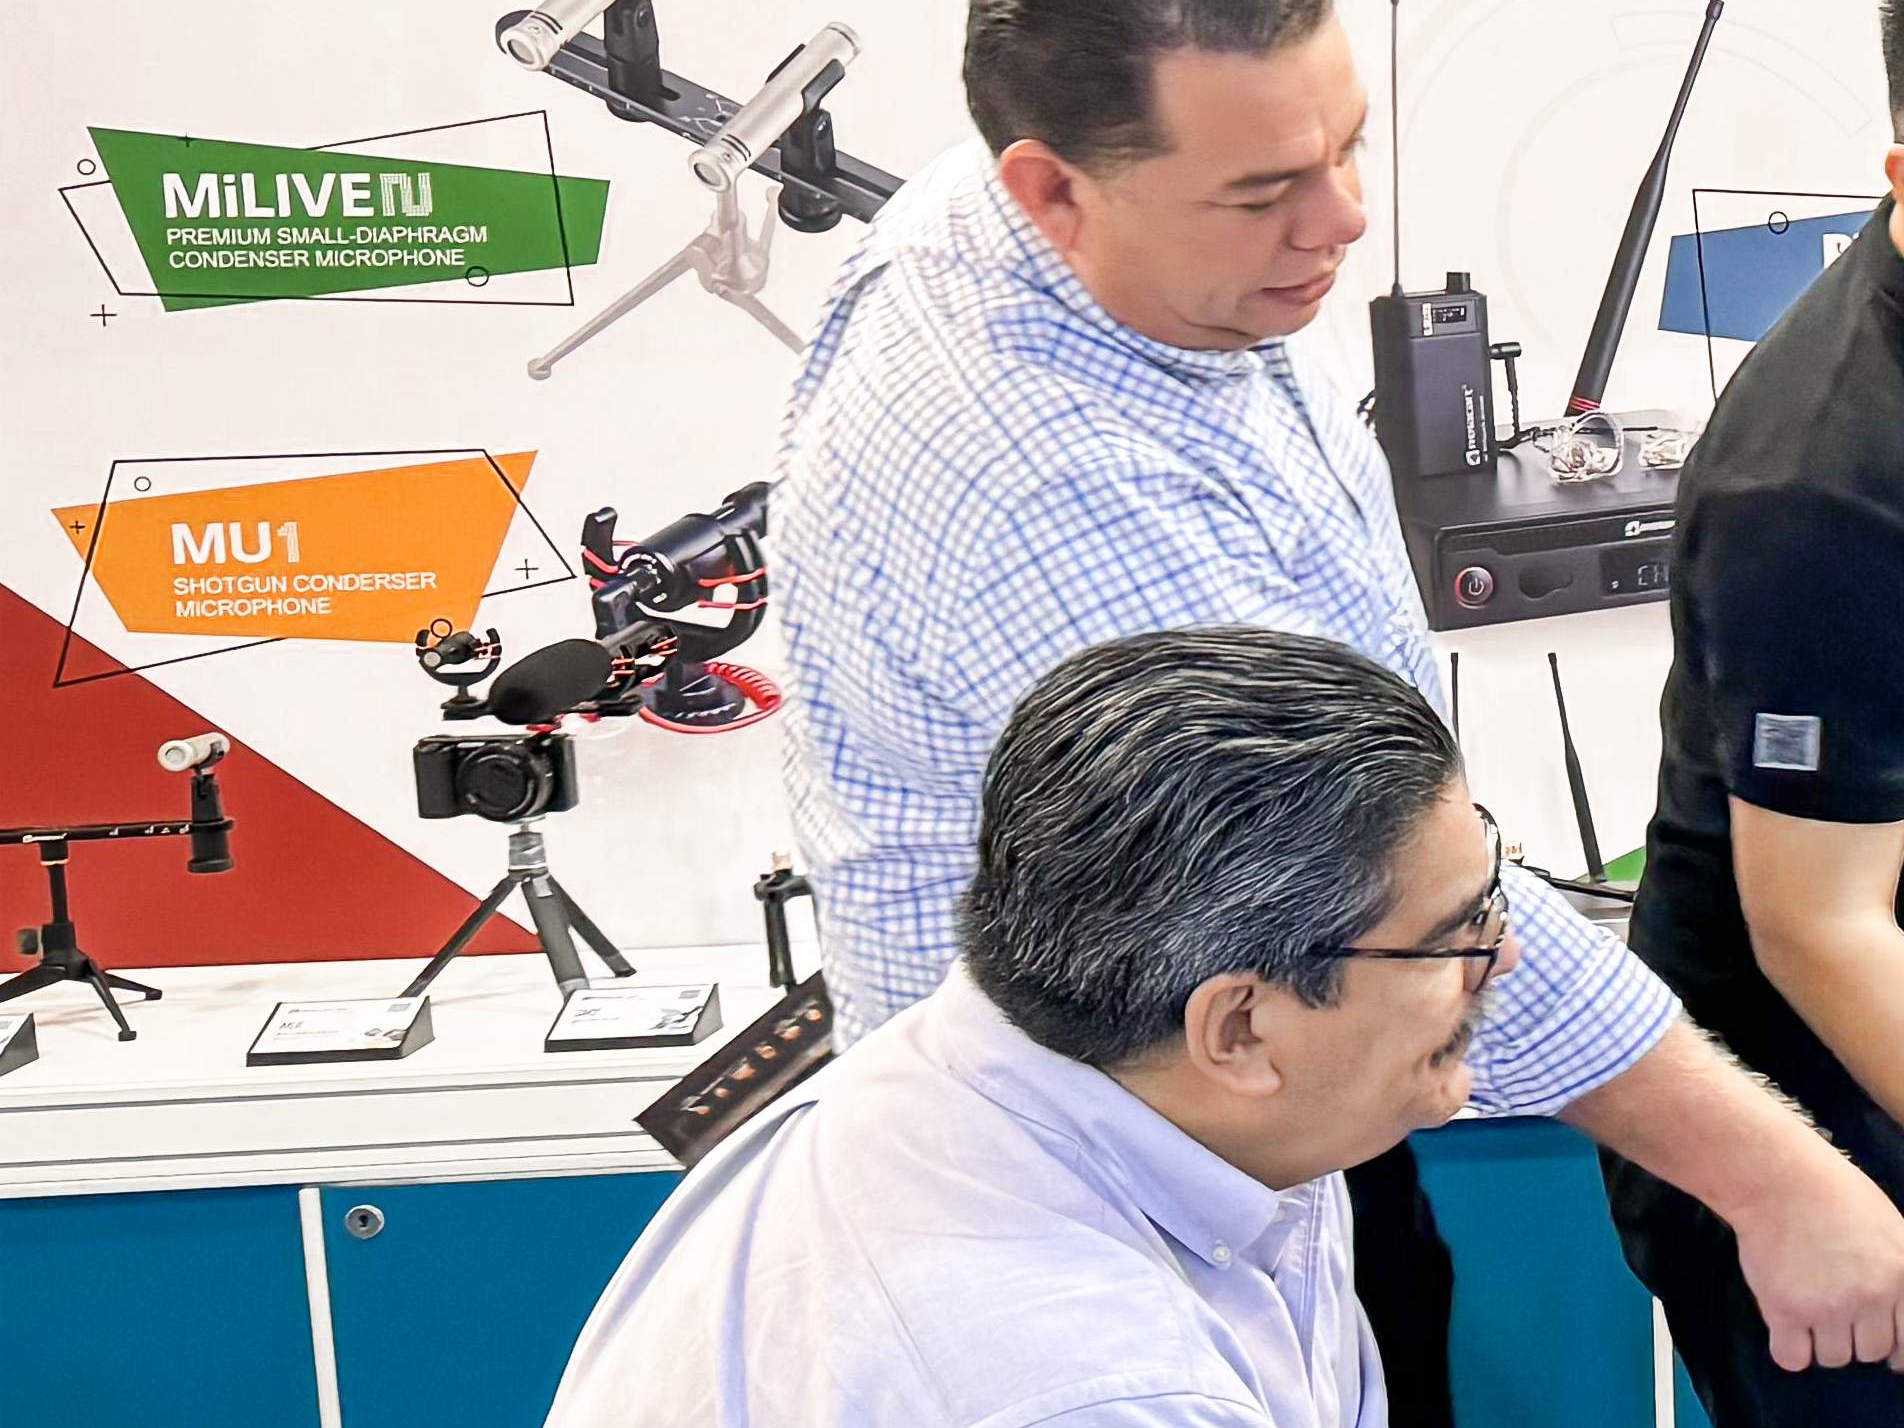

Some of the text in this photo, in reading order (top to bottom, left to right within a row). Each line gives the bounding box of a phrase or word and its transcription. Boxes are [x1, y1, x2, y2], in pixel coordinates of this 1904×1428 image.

[162, 172, 375, 219] MiLIVE
[166, 225, 488, 246] PREMIUM SMALL-DIAPHRAGM
[168, 248, 465, 269] CONDENSER MICROPHONE
[170, 522, 301, 565] MU1
[173, 572, 437, 595] SHOTGUN CONDERSER
[175, 597, 332, 619] MICROPHONE
